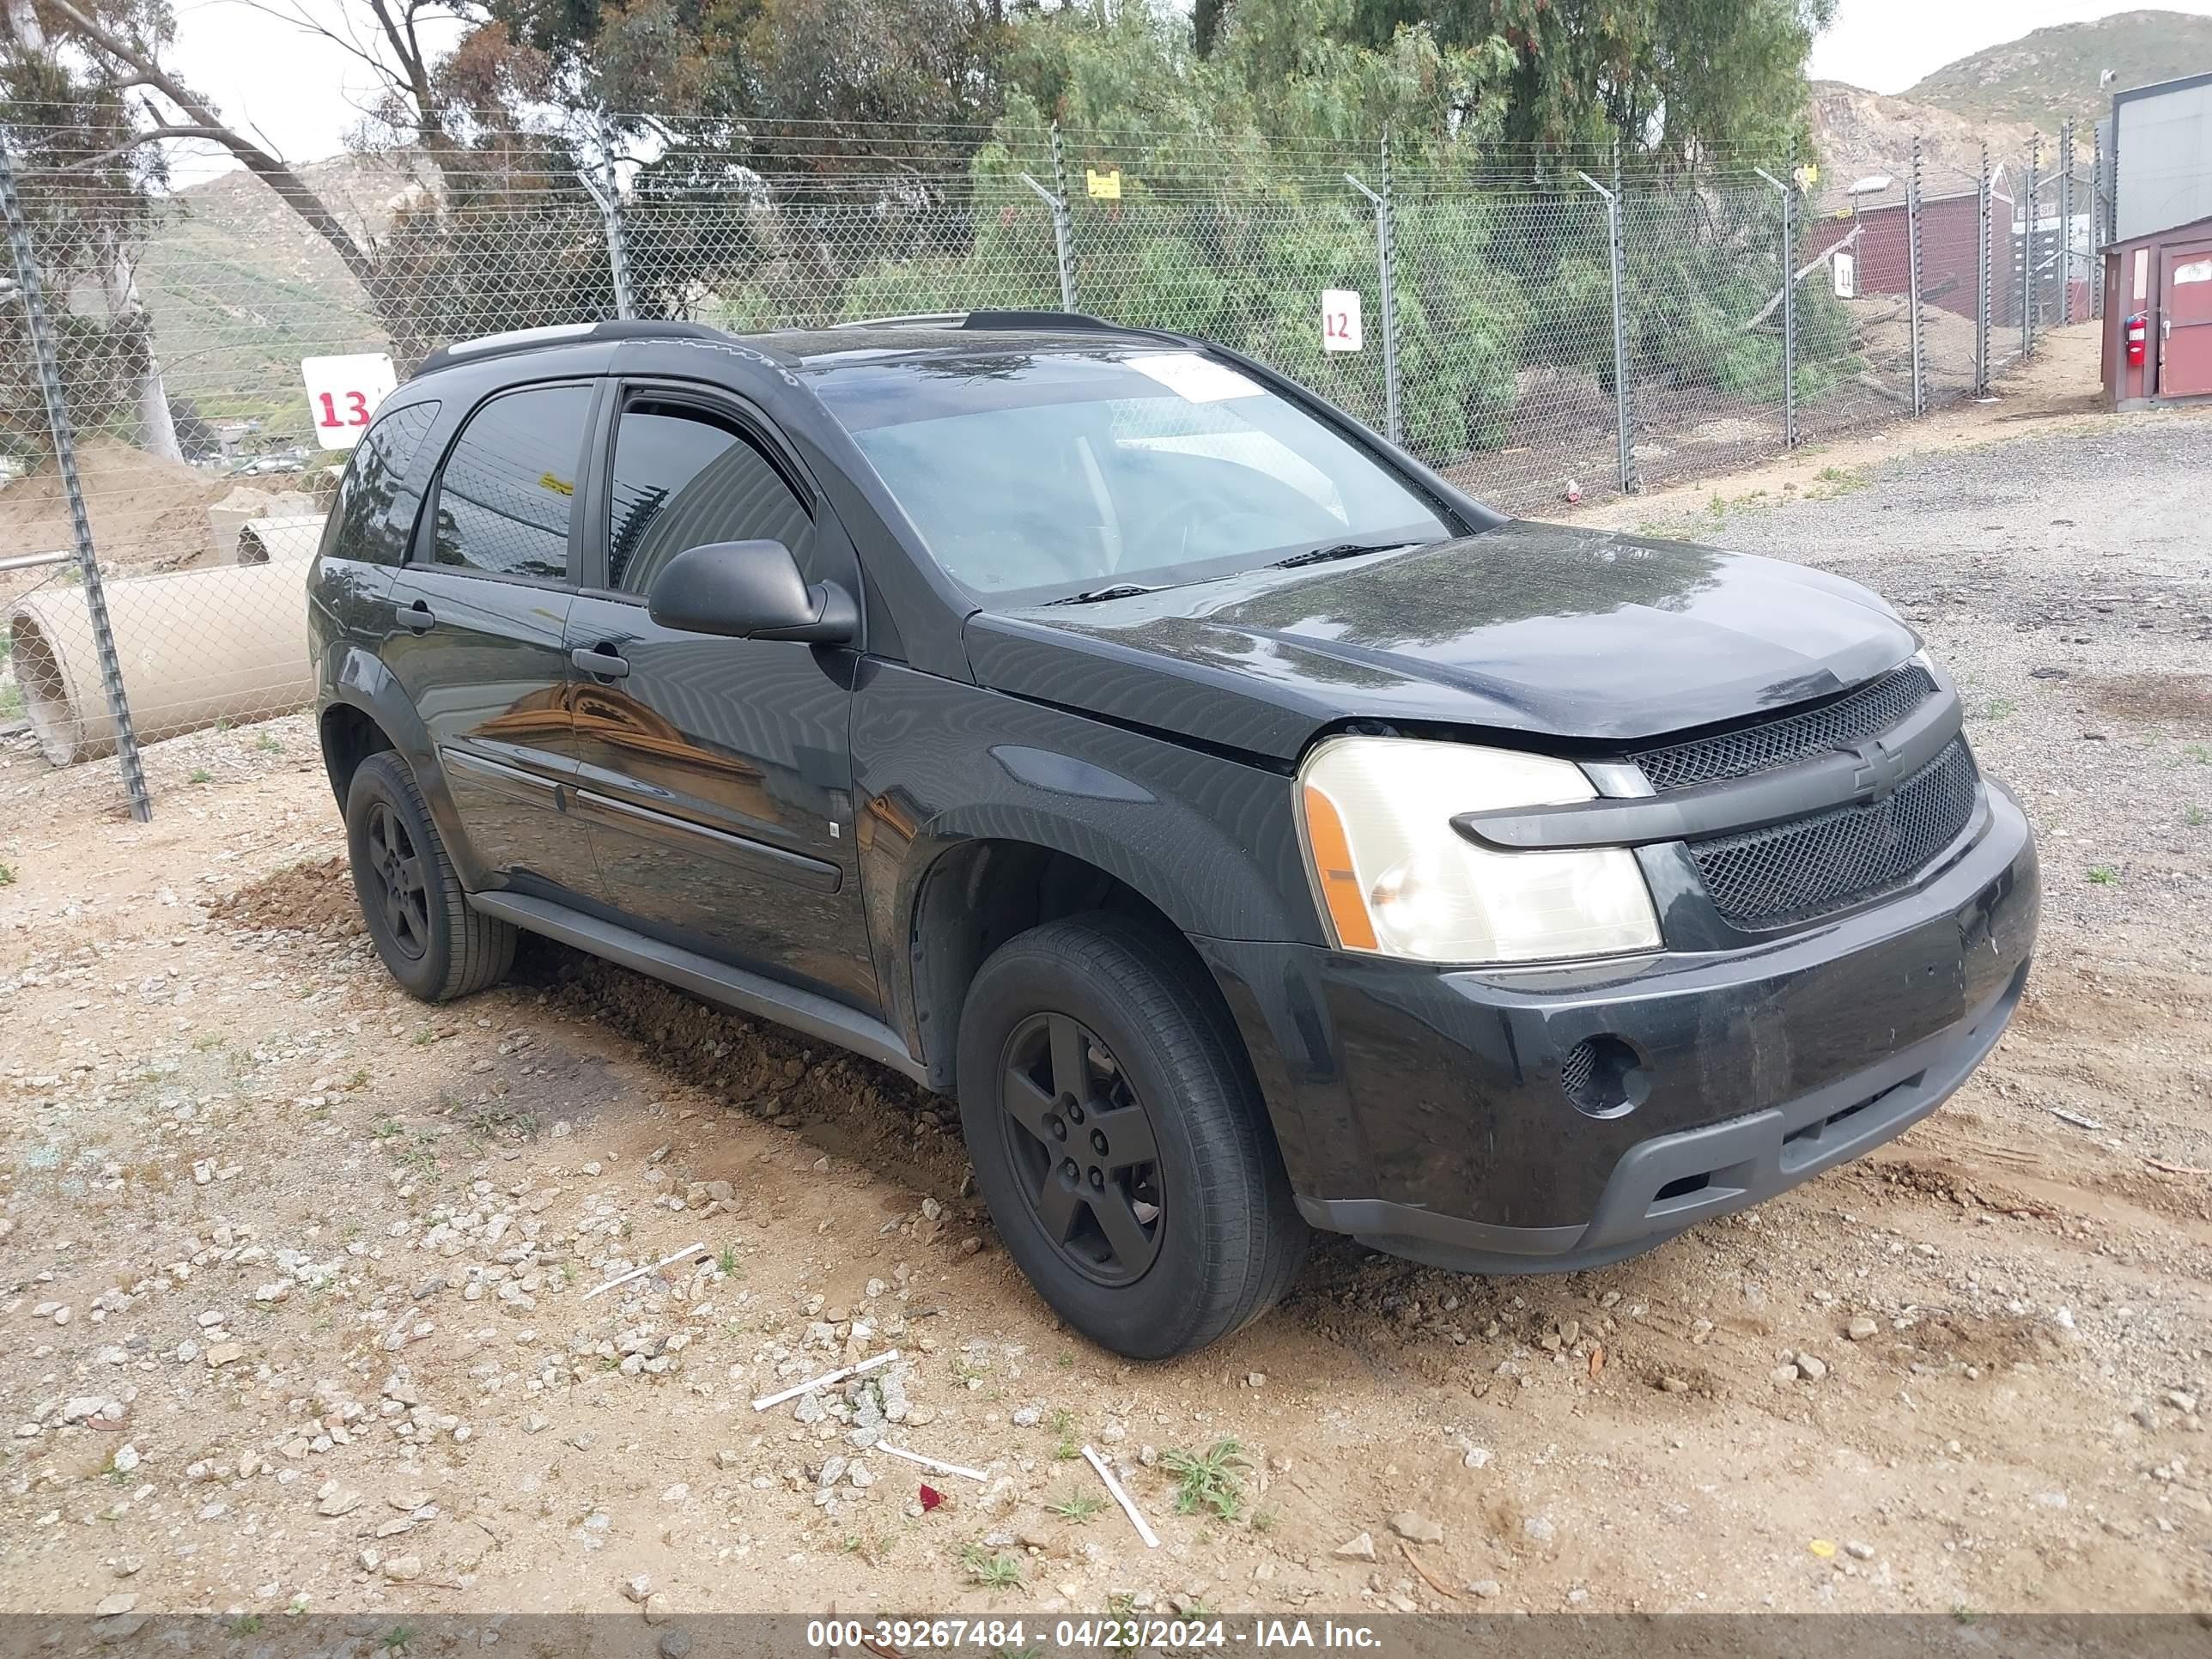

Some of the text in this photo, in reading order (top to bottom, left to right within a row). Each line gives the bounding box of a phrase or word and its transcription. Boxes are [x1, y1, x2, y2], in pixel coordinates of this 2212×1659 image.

[1841, 270, 1851, 287] 11
[1327, 313, 1349, 337] 12
[319, 391, 370, 427] 13
